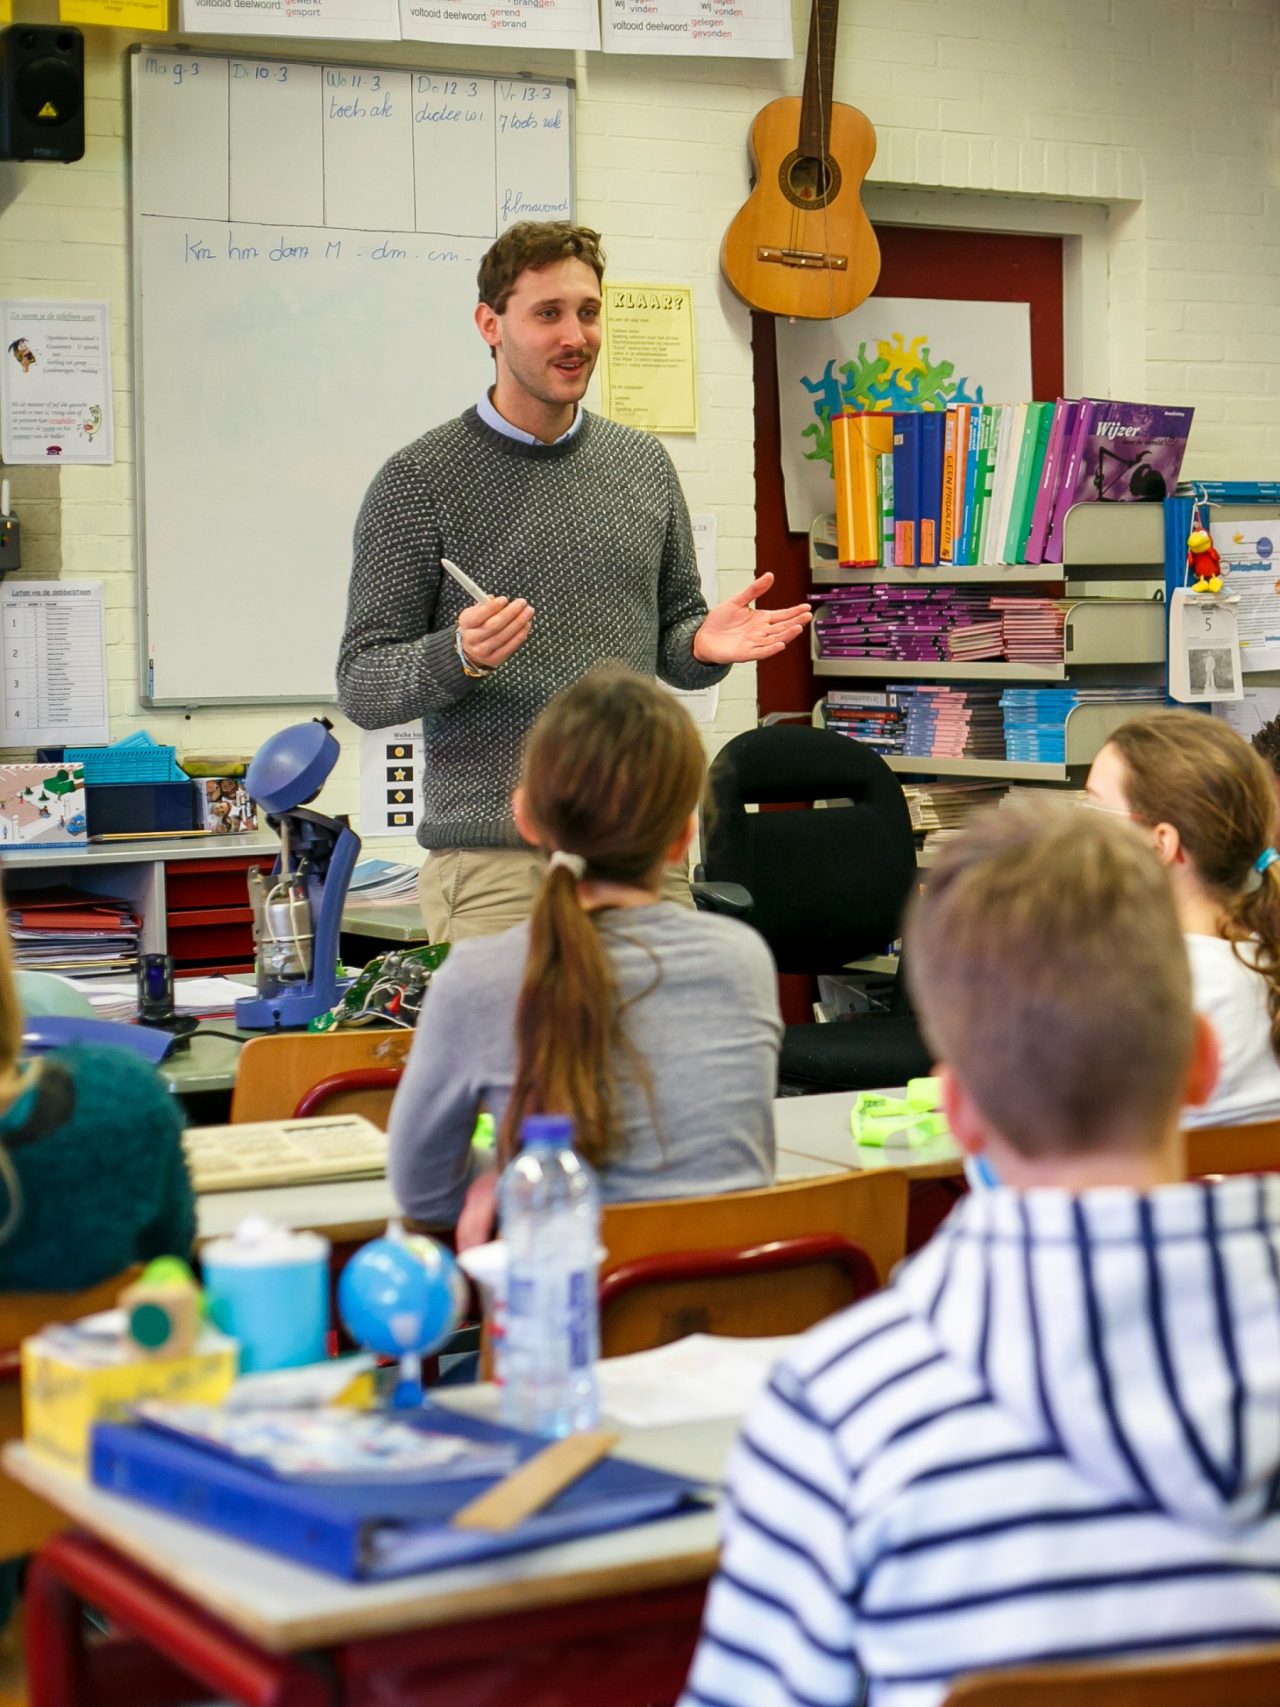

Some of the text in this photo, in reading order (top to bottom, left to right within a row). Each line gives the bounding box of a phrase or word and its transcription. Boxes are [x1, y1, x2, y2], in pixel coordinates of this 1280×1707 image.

[285, 8, 321, 17] gesport
[410, 7, 442, 19] voltooid
[490, 8, 521, 18] gerend
[630, 4, 658, 14] vinden
[714, 8, 743, 17] vonden
[492, 19, 527, 29] gebrand
[612, 21, 644, 31] voltooid
[692, 18, 724, 27] gelegen
[692, 29, 733, 39] gevonden
[613, 292, 684, 311] KLAAR?
[1096, 421, 1141, 440] Wijzer
[1205, 617, 1212, 632] 5
[12, 649, 18, 658] 2
[13, 679, 19, 688] 3
[14, 710, 20, 718] 4
